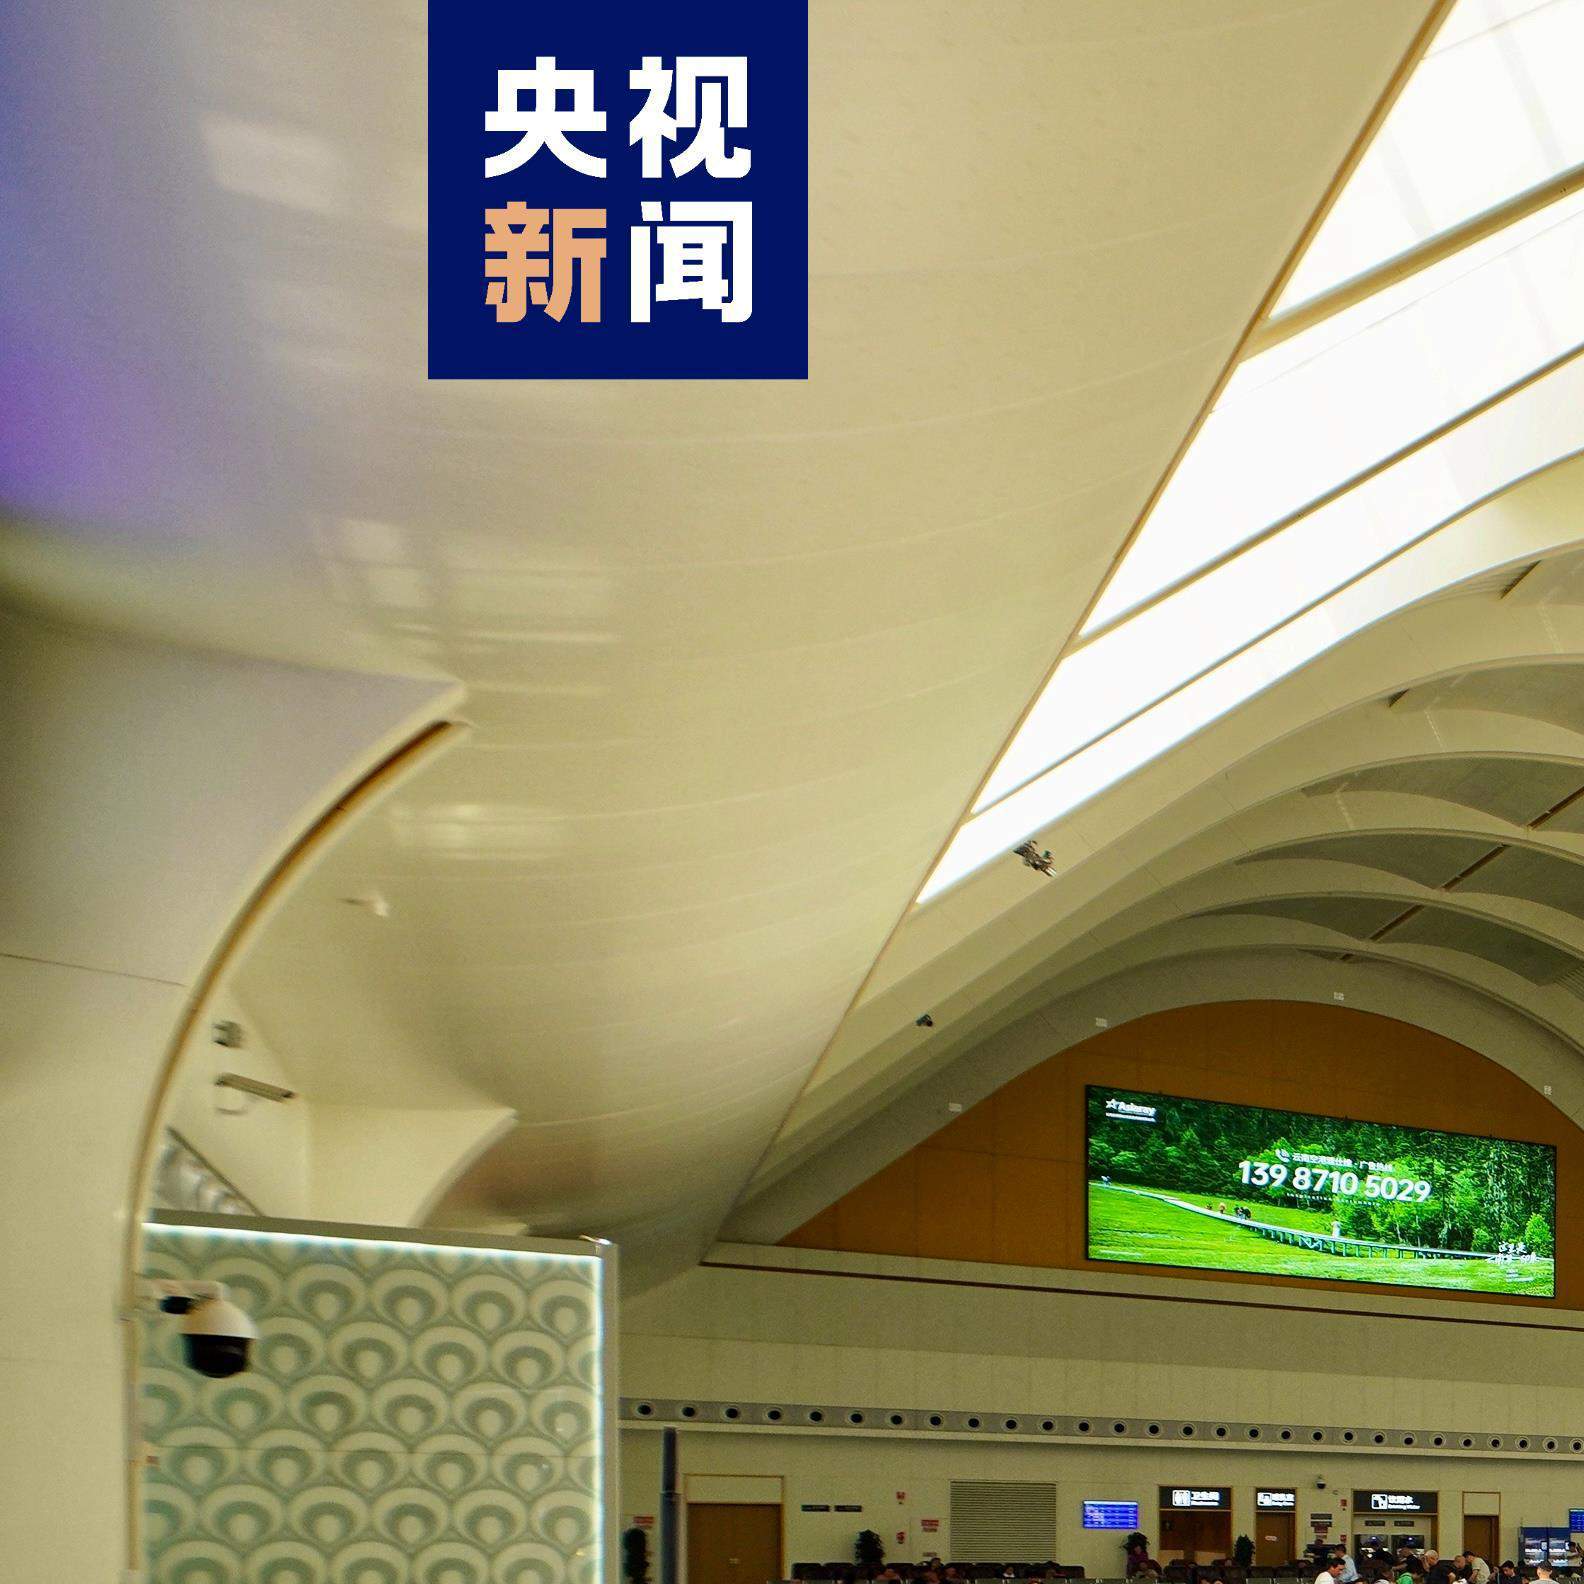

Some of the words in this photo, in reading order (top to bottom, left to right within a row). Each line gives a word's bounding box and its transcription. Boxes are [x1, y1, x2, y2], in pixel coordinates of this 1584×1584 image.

[1238, 1160, 1288, 1187] 139
[1292, 1166, 1359, 1196] 8710
[1364, 1174, 1432, 1203] 5029
